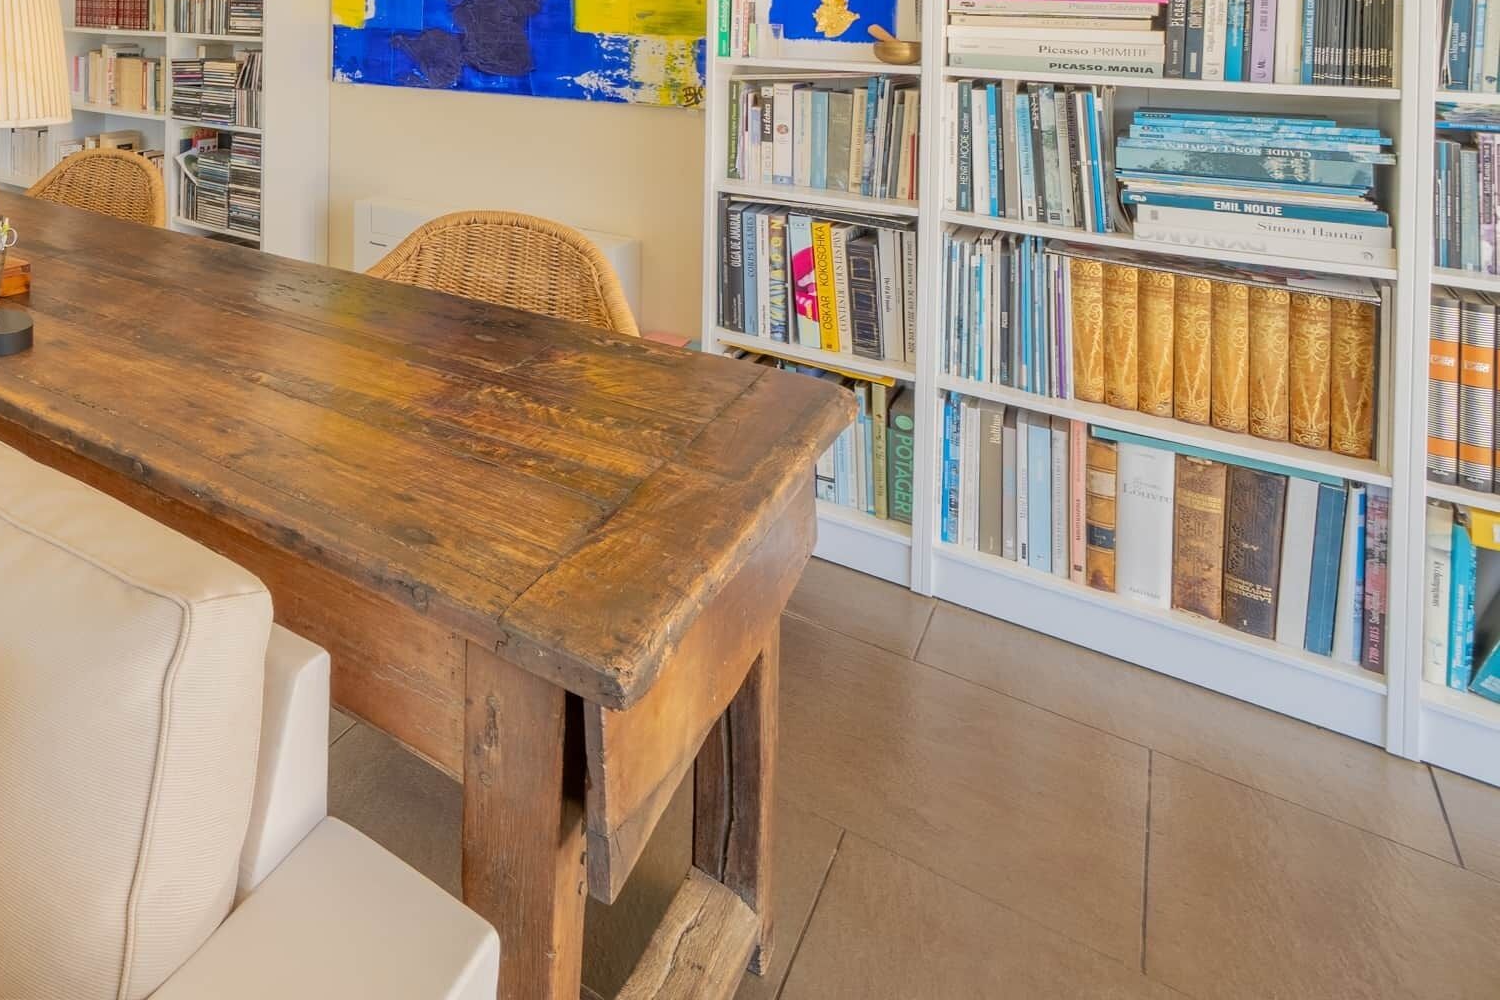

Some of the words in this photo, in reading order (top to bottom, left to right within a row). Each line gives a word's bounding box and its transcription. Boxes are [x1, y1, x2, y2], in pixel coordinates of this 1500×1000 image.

[1038, 45, 1089, 56] Picasso
[1049, 62, 1155, 74] PICASSO.MANIA
[762, 124, 771, 135] Les
[960, 134, 969, 159] MOORE
[1222, 145, 1262, 156] MONET
[1268, 148, 1312, 160] CLAUDE
[960, 160, 969, 185] HENRY
[1213, 200, 1241, 213] EMIL
[1244, 202, 1283, 216] NOLDE
[730, 213, 741, 241] AMARAL
[1257, 222, 1307, 236] Simon
[1312, 225, 1364, 242] Hantaï
[730, 241, 741, 250] DE
[746, 242, 755, 251] ET
[731, 250, 742, 268] OLGA
[746, 252, 755, 278] CORPS
[814, 226, 828, 287] KOKOSCHKA
[820, 295, 833, 331] OSKAR
[989, 414, 1001, 444] Balthus
[895, 434, 913, 514] POTAGER
